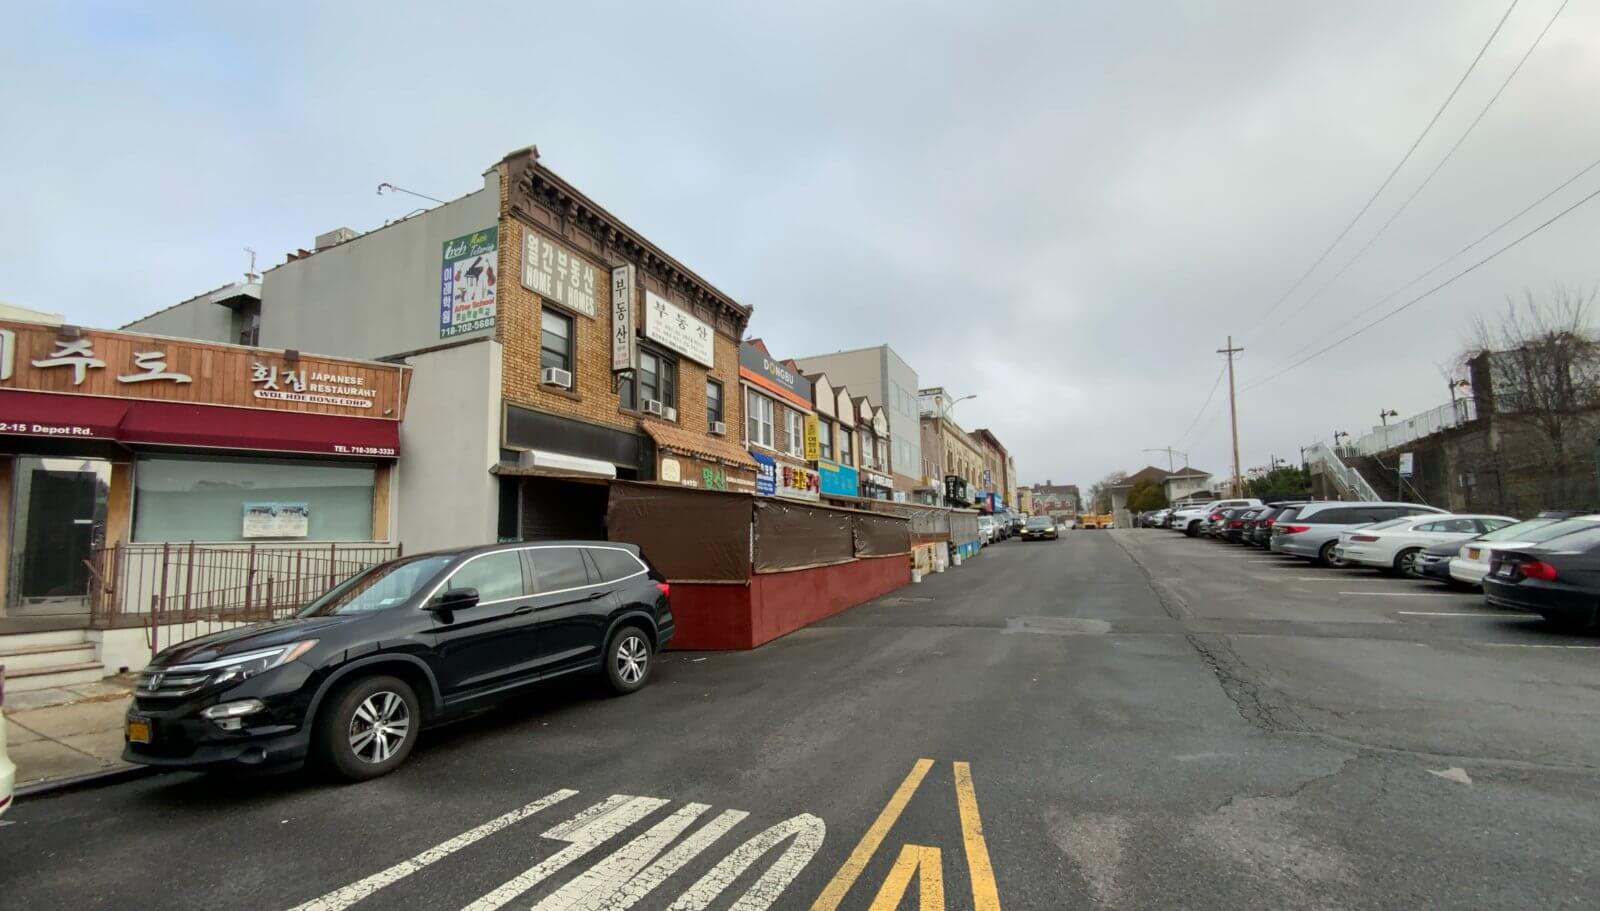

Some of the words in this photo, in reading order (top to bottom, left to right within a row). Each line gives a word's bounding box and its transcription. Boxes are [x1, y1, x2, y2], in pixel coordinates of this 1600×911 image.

[526, 265, 552, 296] HOME
[556, 279, 563, 301] N
[568, 286, 595, 317] HOMES
[615, 279, 628, 344] 부동산
[654, 300, 709, 341] 부동산
[251, 361, 308, 393] 횟집
[311, 371, 364, 386] JAPANESE
[763, 358, 794, 385] DONGBU
[309, 383, 377, 398] RESTAURANT
[32, 424, 69, 436] Depot
[72, 426, 94, 436] Rd.
[334, 445, 350, 453] TEL.
